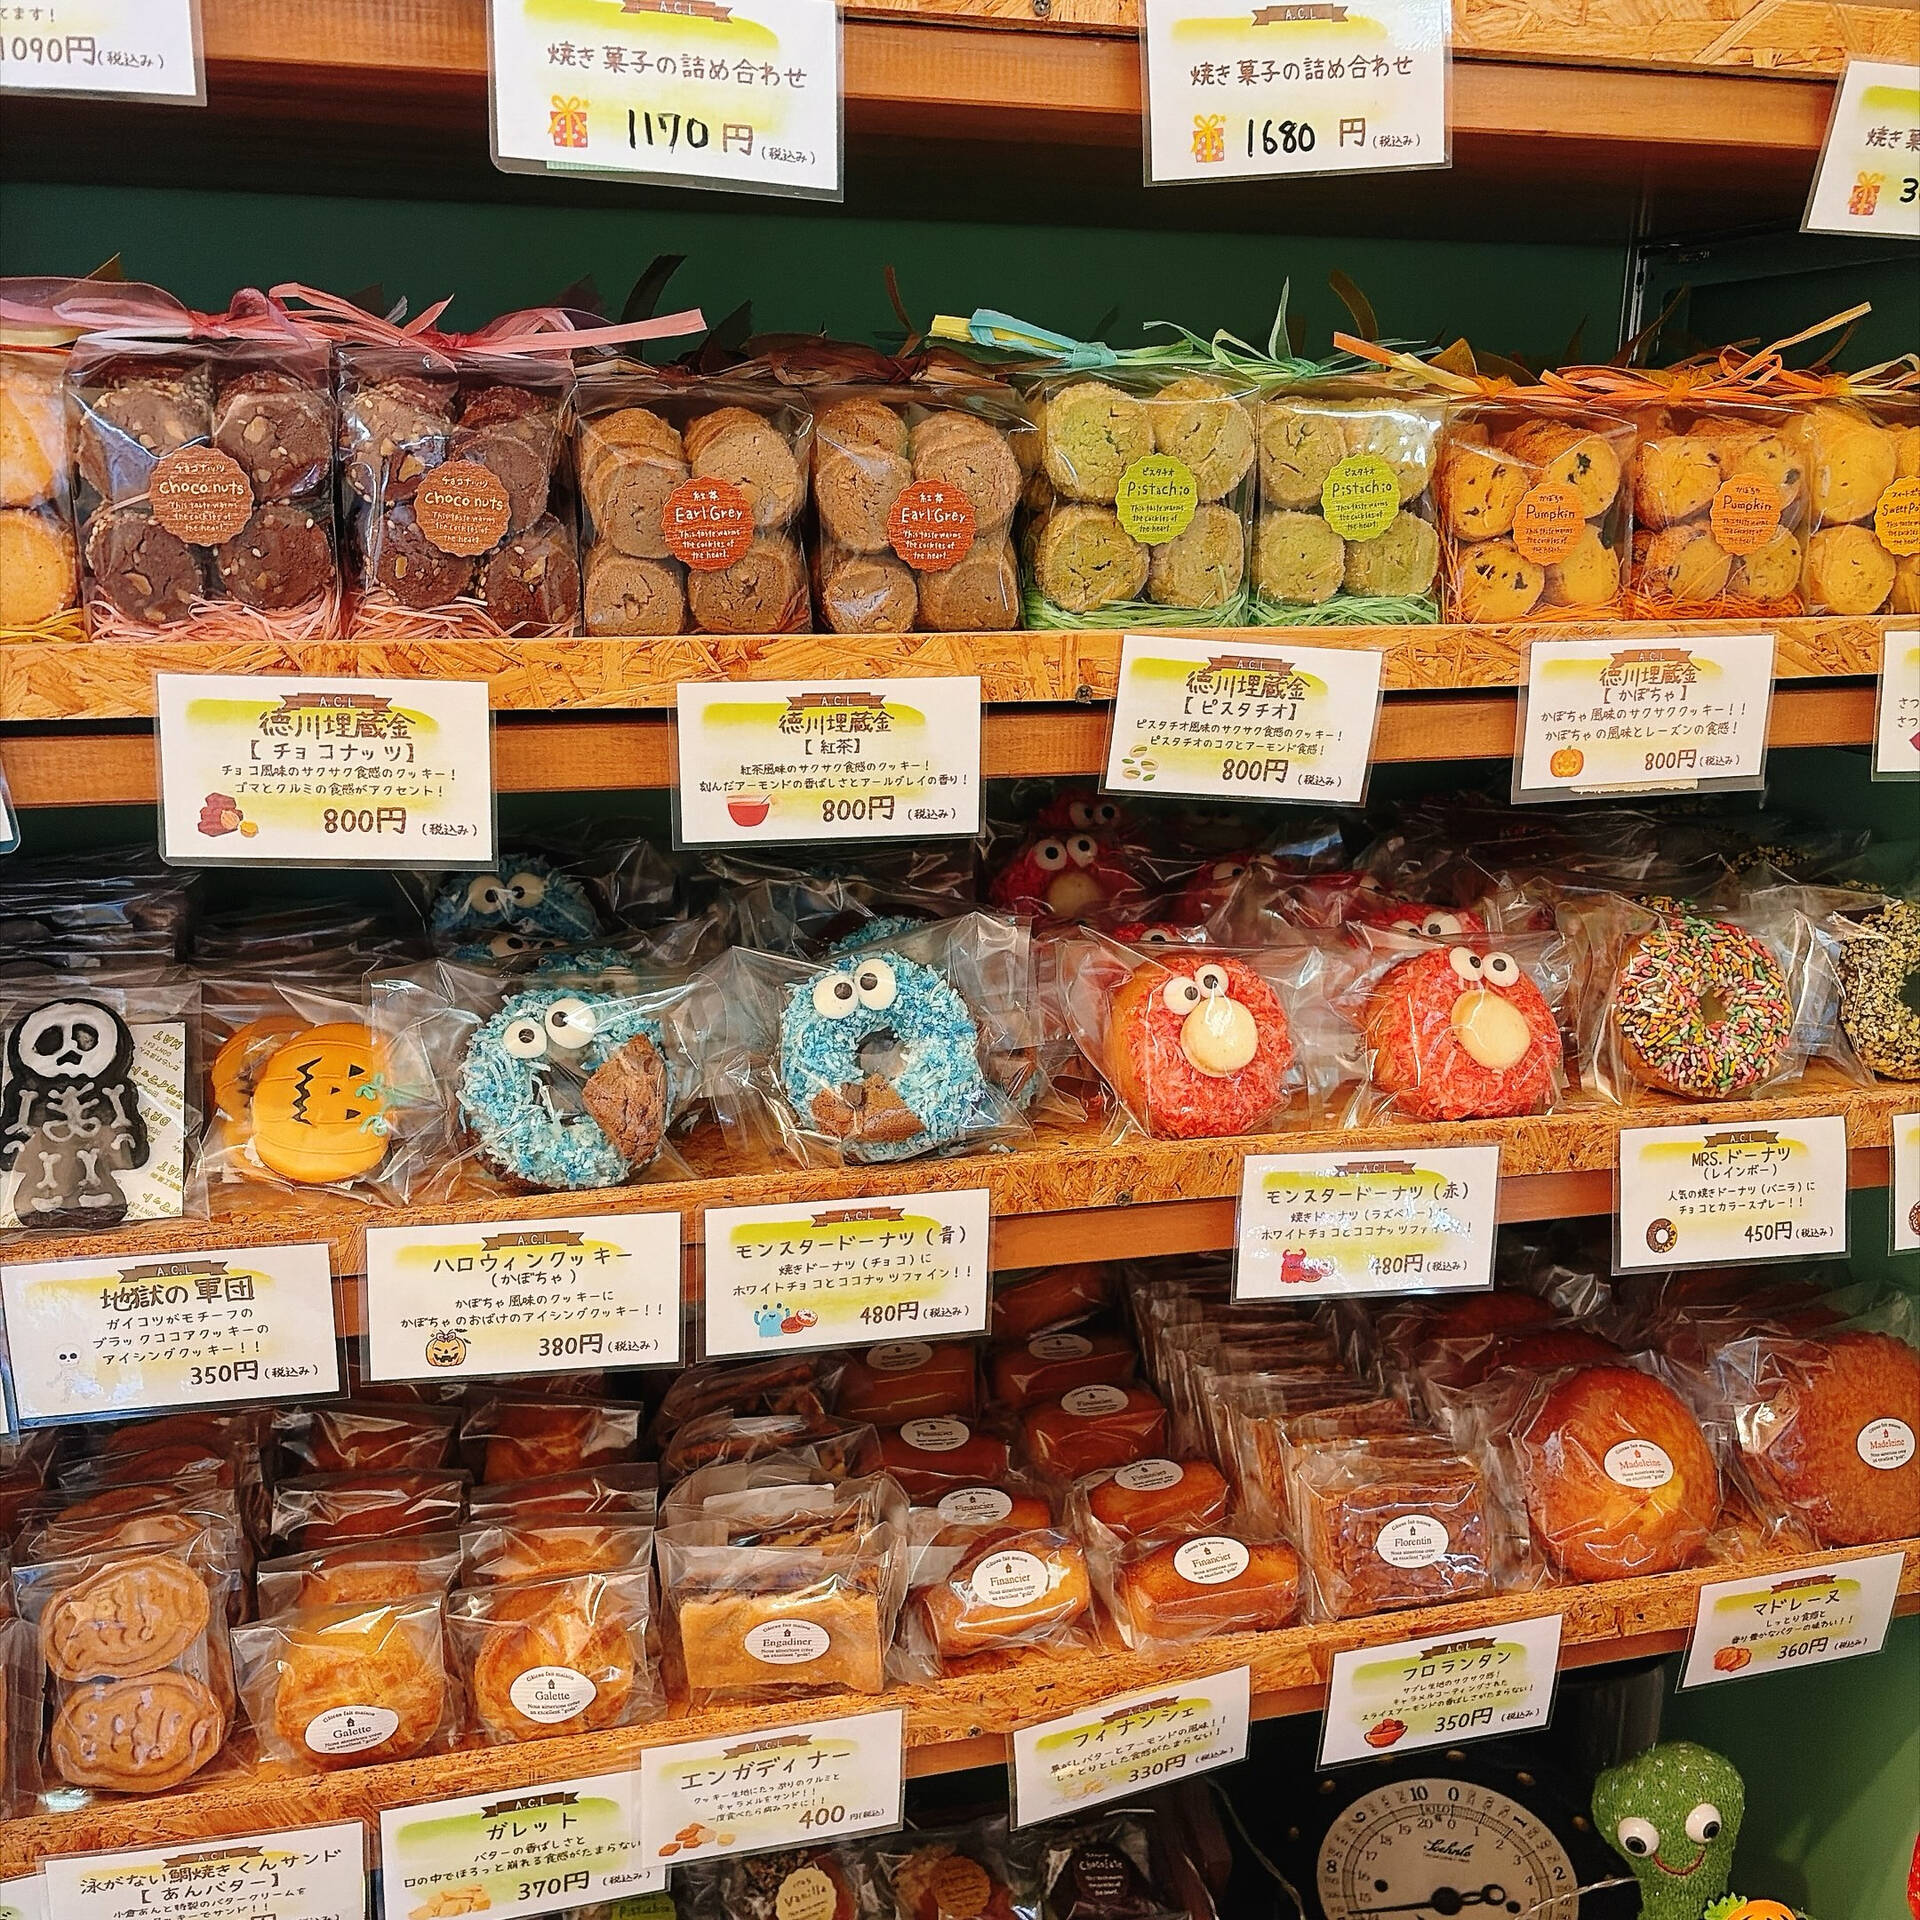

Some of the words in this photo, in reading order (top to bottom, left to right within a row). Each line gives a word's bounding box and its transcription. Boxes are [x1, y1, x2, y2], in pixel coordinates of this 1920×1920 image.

[1285, 7, 1317, 21] A.C.L
[97, 50, 164, 69] (税込み)
[547, 41, 808, 90] 焼き菓子の詰め合わせ
[1190, 54, 1413, 87] 焼き菓子の詰め合わせ
[628, 108, 709, 154] 1170
[722, 122, 754, 156] 円
[761, 146, 816, 166] (税込み)
[1247, 119, 1316, 158] 1680
[1339, 117, 1367, 148] 円
[1372, 134, 1422, 149] (税込み)
[1142, 466, 1175, 477] ピスタチオ
[159, 478, 209, 495] Choco
[212, 480, 244, 495] nuts
[1127, 480, 1190, 497] Pistachio
[1332, 479, 1392, 498] Pistachio
[424, 490, 470, 508] Choco
[474, 495, 504, 511] nuts
[1722, 494, 1772, 513] Pumpkin
[675, 506, 707, 523] Earl
[709, 505, 743, 521] Grey
[901, 507, 931, 523] Earl
[934, 508, 966, 524] Grey
[1526, 504, 1575, 522] Pumpkin
[1185, 669, 1311, 702] 徳川埋蔵金
[1599, 662, 1702, 688] 徳川埋蔵金
[318, 696, 356, 709] A.C.L
[821, 695, 853, 707] A.C.L
[1603, 684, 1689, 706] 【かぼちゃ】
[1183, 696, 1298, 721] 【ピスタチオ】
[258, 710, 417, 741] 徳川埋蔵金
[778, 710, 895, 735] 徳川埋蔵金
[1136, 718, 1343, 742] ピスタチオ風味のサクサク食感のクッキー!
[1545, 720, 1738, 742] かぼちゃの風味とレーズンの食感!
[250, 739, 416, 763] 【チョコナッツ】
[804, 737, 861, 756] 【紅茶】
[1149, 735, 1325, 756] ピスタチオのコクとアーモンド食感!
[739, 759, 930, 777] 紅茶風味のサクサク食感のクッキー!
[1644, 749, 1697, 771] 800円
[1699, 754, 1740, 767] (税込み)
[220, 763, 457, 782] チョコ風味のサクサク食感のクッキー!
[1222, 758, 1289, 784] 800円
[1297, 773, 1343, 787] (税込み)
[234, 782, 444, 798] ゴマとクルミの食感がアクセント!
[822, 794, 896, 823] 800円
[906, 806, 957, 821] (税込み)
[323, 806, 407, 835] 800円
[421, 822, 479, 838] (税込み)
[1730, 1133, 1755, 1143] A.C.L
[1703, 1163, 1779, 1181] (レインボー)
[1266, 1180, 1470, 1205] モンスタードーナツ(赤)
[1668, 1180, 1816, 1201] 人気の焼きドーナツ(バニラ)に
[843, 1210, 875, 1223] A.C.L
[1678, 1196, 1804, 1216] チョコとカラースプレー!!
[517, 1233, 551, 1246] A.C.L
[735, 1224, 968, 1260] モンスタードーナツ(青)
[1744, 1220, 1793, 1243] 450円
[1795, 1226, 1835, 1240] (税込み)
[433, 1247, 633, 1274] ハロウィンクッキー
[778, 1252, 932, 1277] 焼きドーナツ(チョコ)に
[1426, 1259, 1469, 1273] (税込み)
[156, 1266, 193, 1278] A.C.L
[491, 1268, 577, 1289] (かぼちゃ)
[100, 1274, 256, 1313] 地獄の軍団
[455, 1290, 615, 1310] かぼちゃ風味のクッキーに
[106, 1307, 254, 1331] ガイコツがモチーフの
[859, 1300, 920, 1326] 480円
[923, 1305, 970, 1320] (税込み)
[92, 1322, 270, 1350] ブラックココアクッキーの
[538, 1332, 604, 1358] 380円
[607, 1338, 660, 1353] (税込み)
[102, 1340, 262, 1366] アイシングクッキー!!
[190, 1359, 260, 1386] 350円
[264, 1363, 320, 1381] (税込み)
[1394, 1535, 1432, 1548] Florentin
[1191, 1552, 1231, 1568] Financier
[989, 1572, 1031, 1587] Financier
[1753, 1589, 1841, 1616] マドレーヌ
[762, 1637, 813, 1648] Engadiner
[1777, 1636, 1829, 1660] 360円
[1833, 1637, 1868, 1651] (税込み)
[1402, 1651, 1512, 1682] フロランタン
[534, 1690, 571, 1701] Galette
[1073, 1707, 1195, 1748] フィナンシェ
[1434, 1706, 1494, 1733] 350円
[1500, 1707, 1540, 1723] (税込み)
[332, 1726, 372, 1739] Galette
[680, 1750, 851, 1791] エンガディナー
[1128, 1753, 1187, 1784] 330円
[1194, 1746, 1235, 1765] (税込み)
[514, 1797, 548, 1811] A.C.L
[1409, 1785, 1429, 1802] 10
[1447, 1786, 1459, 1802] 0
[485, 1812, 578, 1842] ガレット
[798, 1805, 846, 1830] 400
[1417, 1817, 1434, 1830] 20
[473, 1835, 586, 1863] バターの香ばしさと
[1495, 1839, 1505, 1851] 2
[1326, 1859, 1338, 1874] 8
[1512, 1854, 1522, 1866] 3
[80, 1849, 342, 1895] 泳がない鯛焼きくんサンド
[1552, 1865, 1567, 1881] 2
[141, 1872, 281, 1904] 【あんバター】
[517, 1870, 590, 1901] 370円
[602, 1870, 651, 1887] (税込み)
